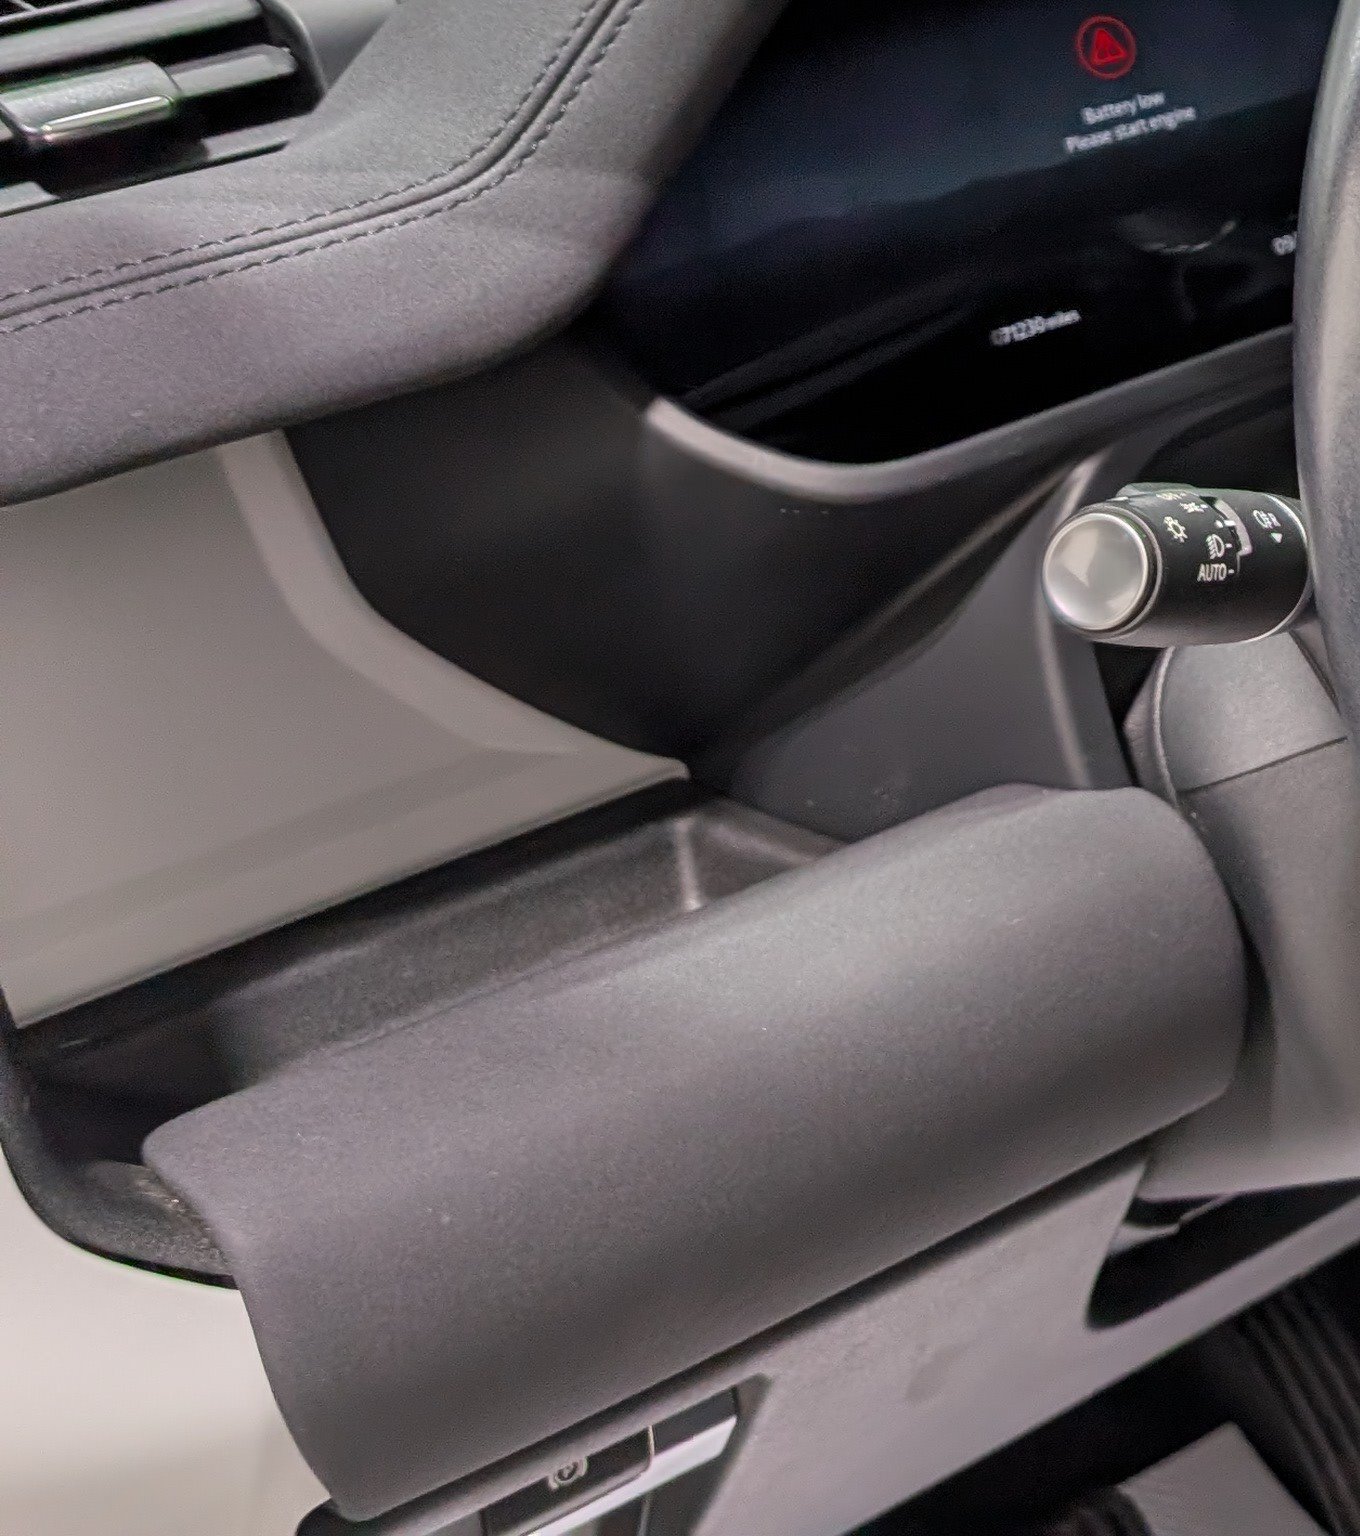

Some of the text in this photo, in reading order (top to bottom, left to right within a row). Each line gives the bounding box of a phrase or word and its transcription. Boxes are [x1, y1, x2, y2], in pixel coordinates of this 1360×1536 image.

[1081, 92, 1165, 125] Battery low
[1064, 130, 1113, 154] Please
[1196, 562, 1227, 582] AUTO
